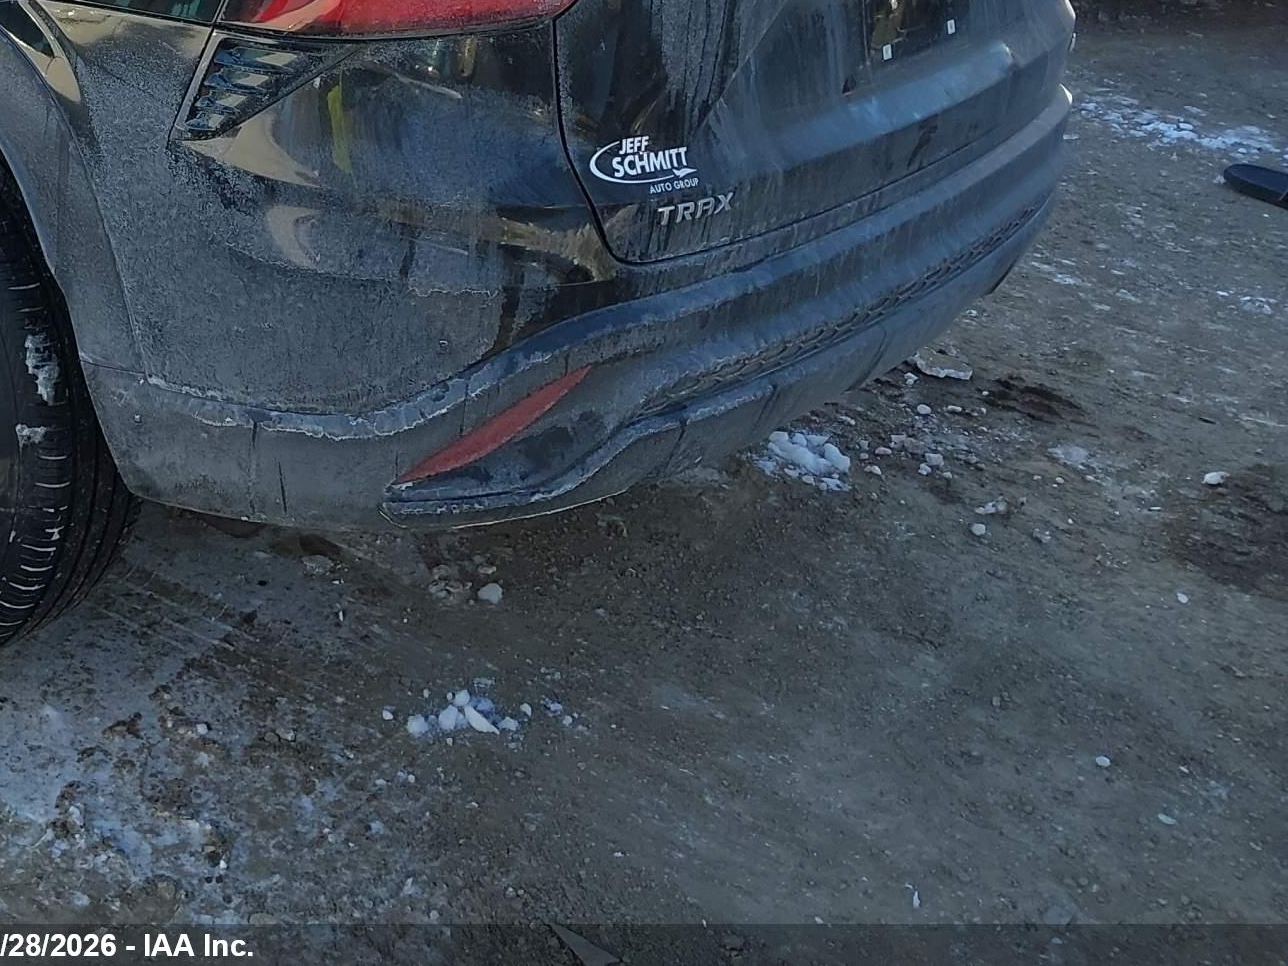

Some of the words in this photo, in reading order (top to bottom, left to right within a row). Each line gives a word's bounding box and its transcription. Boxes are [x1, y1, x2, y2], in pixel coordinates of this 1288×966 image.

[619, 136, 649, 155] JEFF
[612, 146, 688, 178] SCHMITT
[649, 183, 672, 195] AUTO
[673, 177, 699, 191] GROUP
[657, 192, 734, 226] TRAX
